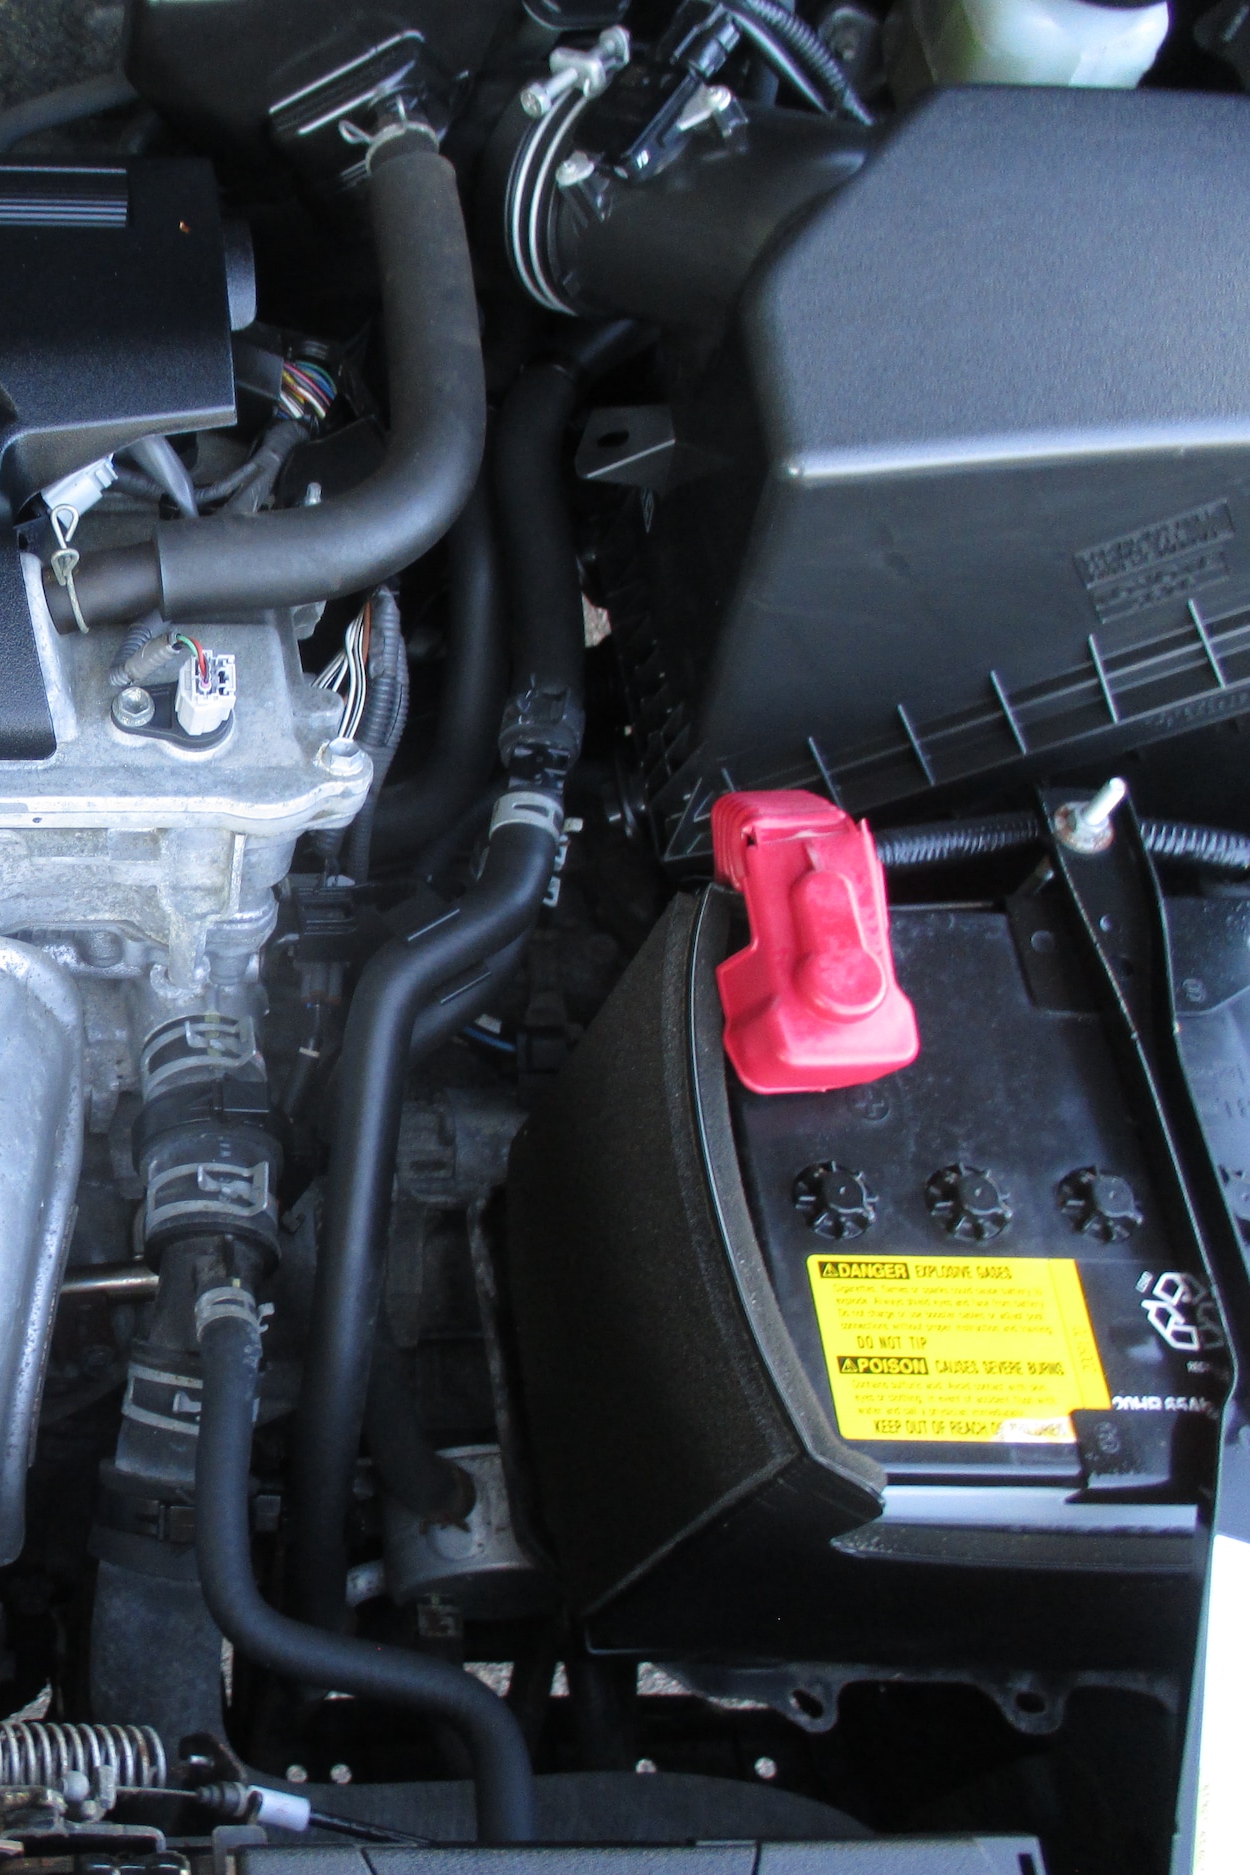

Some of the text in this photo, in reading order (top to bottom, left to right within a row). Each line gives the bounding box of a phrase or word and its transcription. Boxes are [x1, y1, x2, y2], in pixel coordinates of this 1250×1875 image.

[837, 1263, 908, 1278] DANGER
[914, 1265, 972, 1279] EXPLOSIVE
[856, 1335, 928, 1349] DO NOT TIP
[857, 1358, 928, 1374] POISON
[934, 1360, 980, 1374] CAUSES
[982, 1361, 1024, 1375] SEVERE
[875, 1419, 902, 1434] KEEP
[905, 1420, 928, 1434] OUT
[931, 1420, 945, 1435] OF
[949, 1420, 988, 1435] REACH
